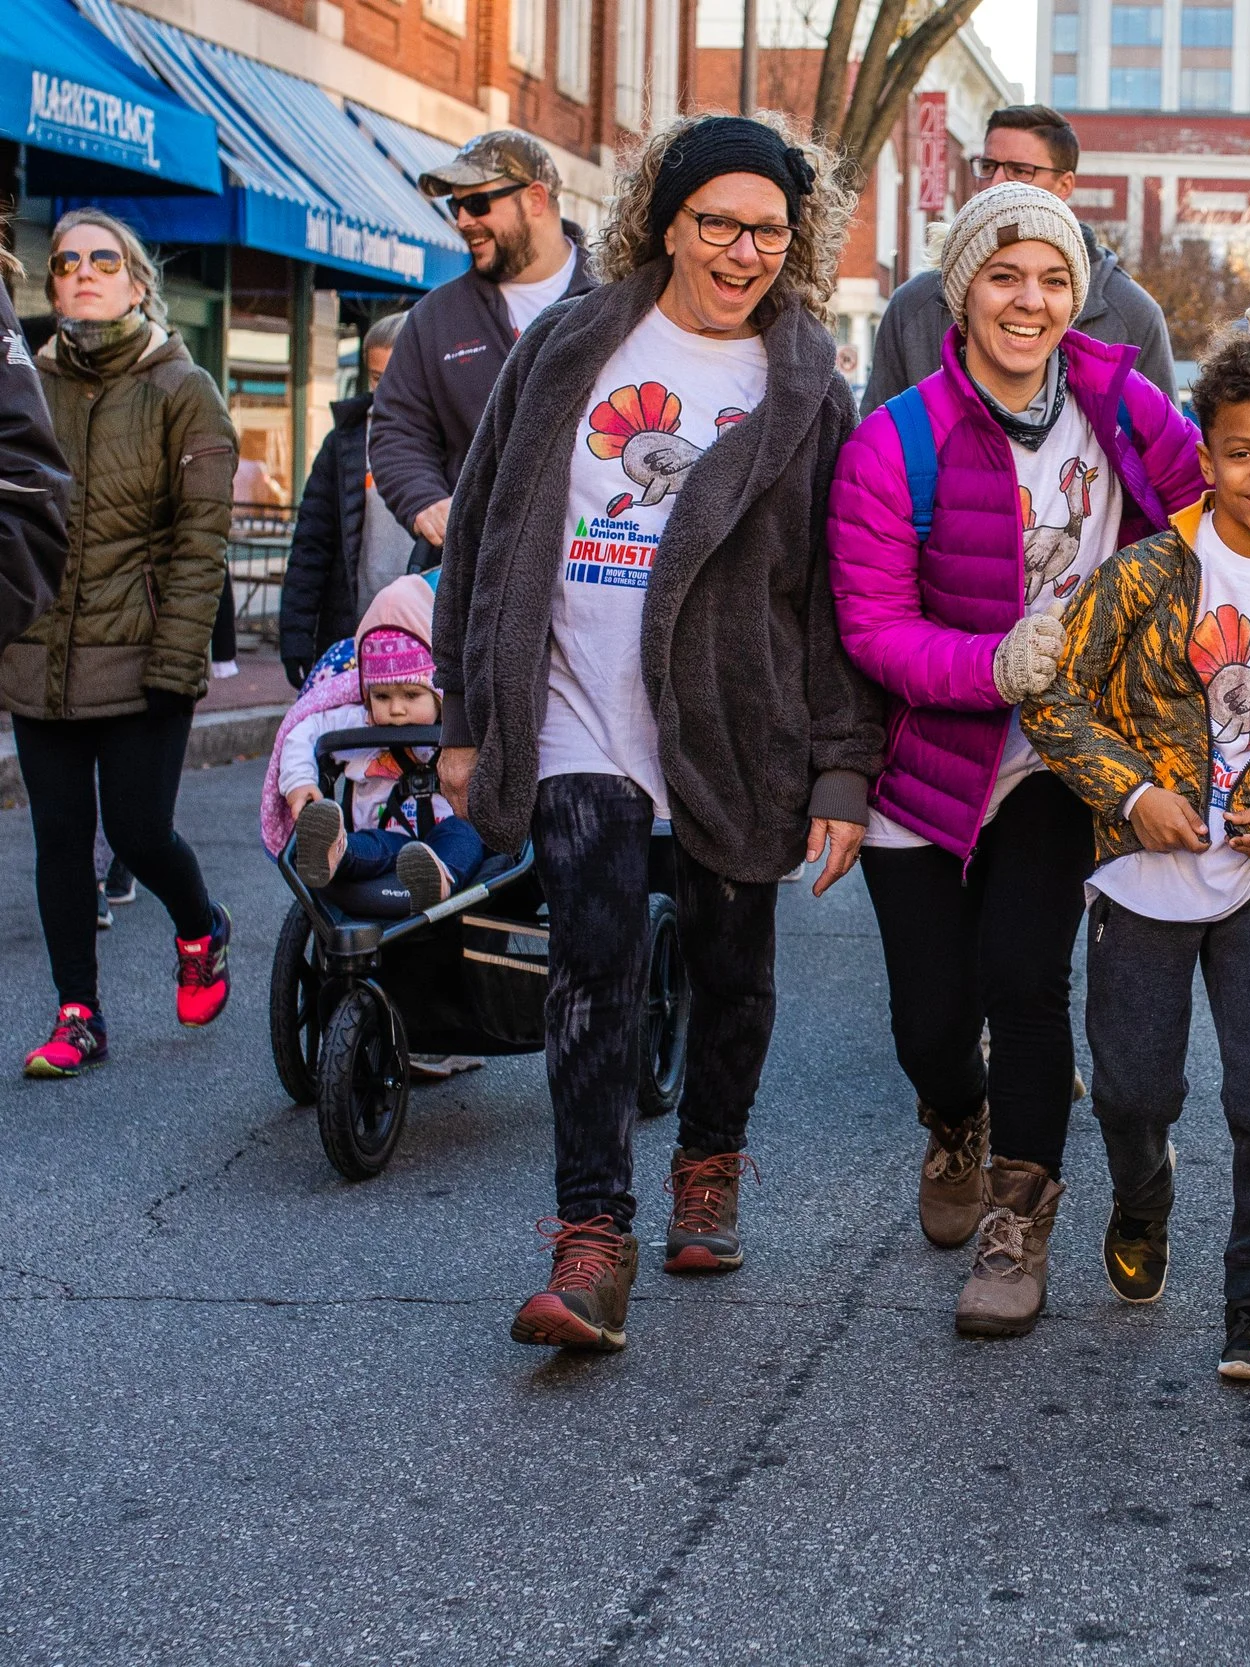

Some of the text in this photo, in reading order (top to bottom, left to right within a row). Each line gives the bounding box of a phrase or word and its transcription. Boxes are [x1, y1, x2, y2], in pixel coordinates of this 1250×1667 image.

[27, 71, 160, 169] MARKETPLACE
[591, 518, 640, 531] Atlantic
[589, 528, 660, 544] Union Bank
[606, 569, 648, 580] MOVE YOUR
[613, 578, 636, 586] OTHERS
